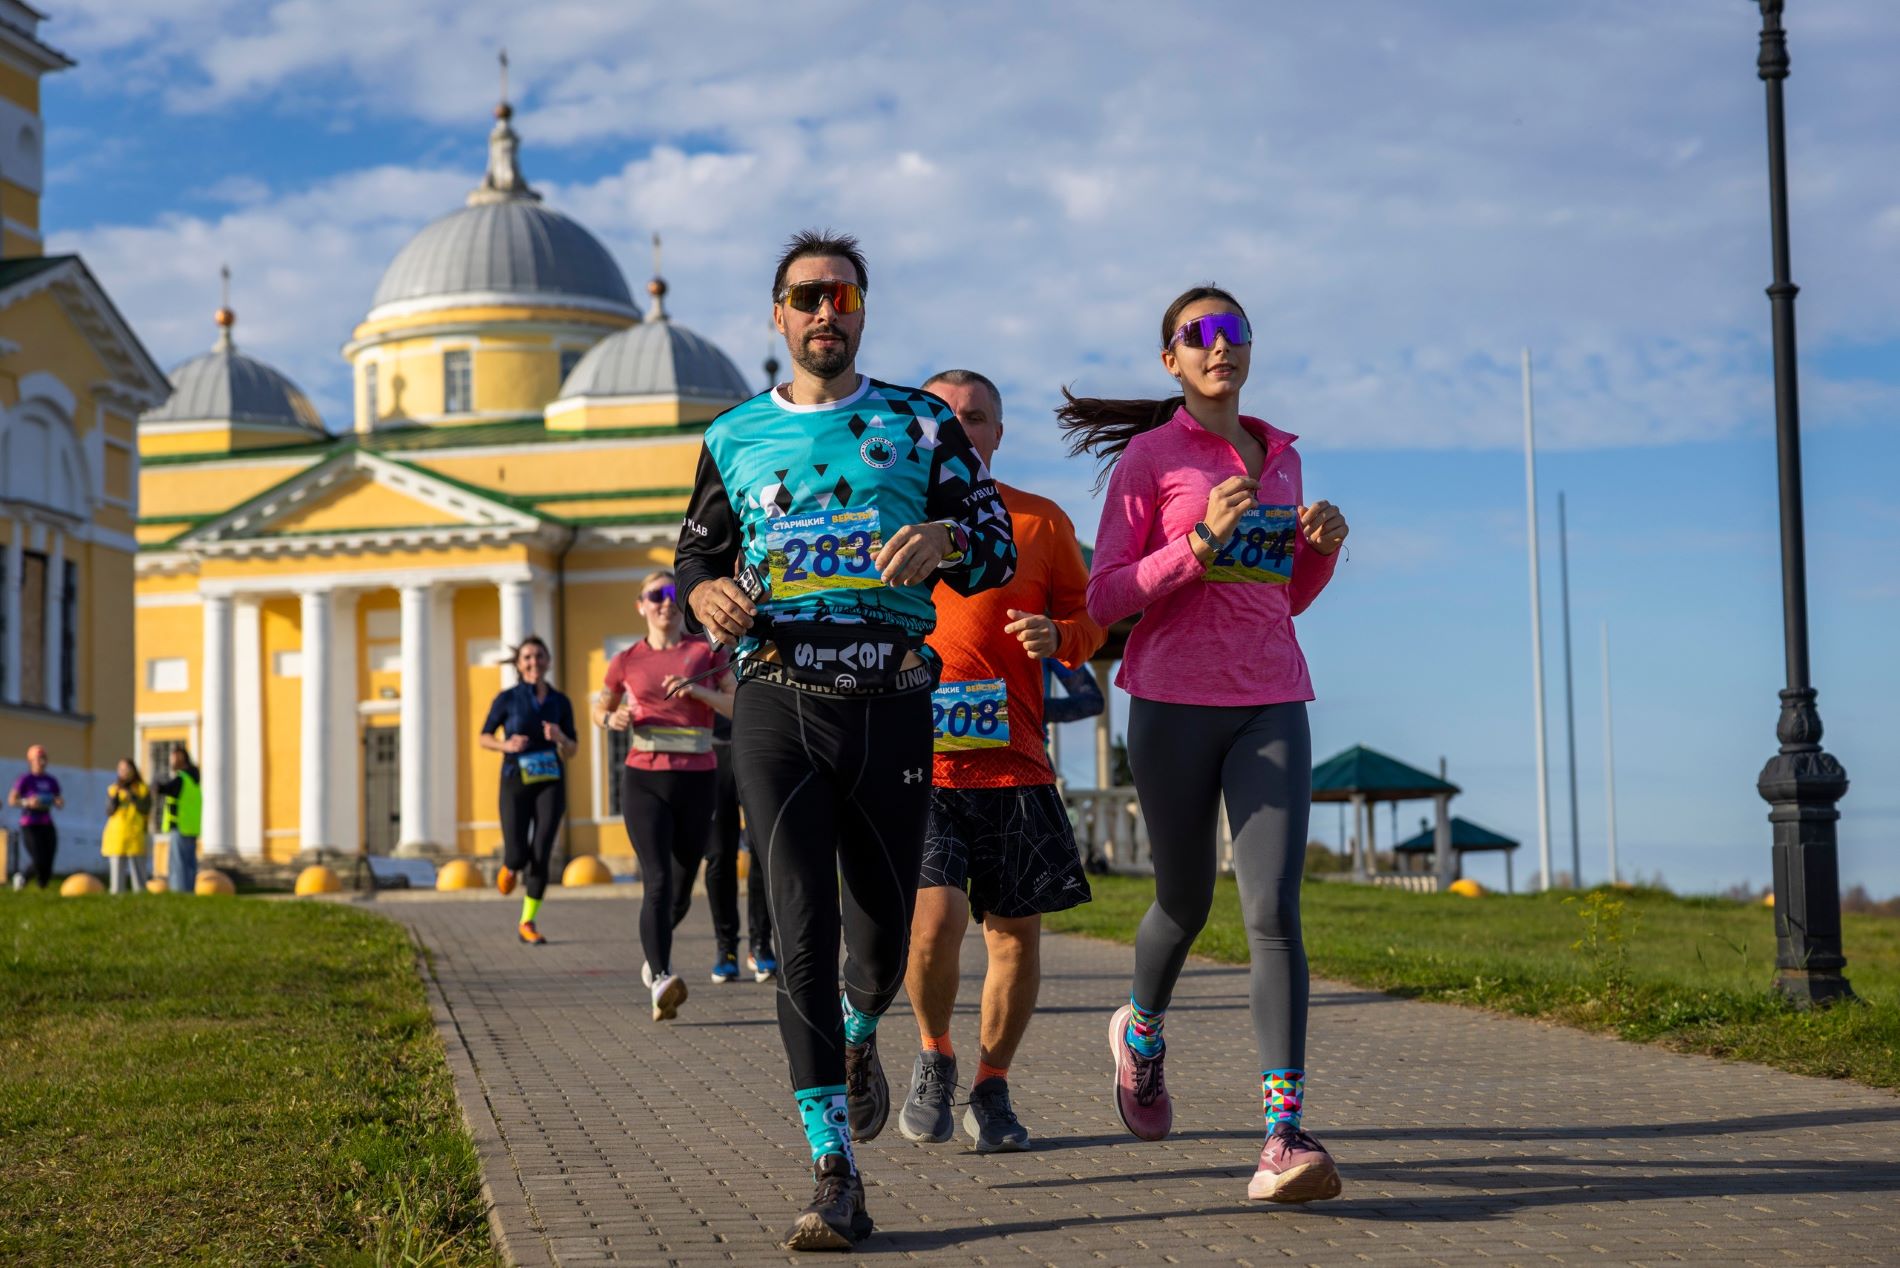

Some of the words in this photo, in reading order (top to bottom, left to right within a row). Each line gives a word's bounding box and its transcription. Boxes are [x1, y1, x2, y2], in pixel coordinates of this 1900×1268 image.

[772, 517, 825, 531] СТАРИЦКИЕ
[782, 530, 872, 582] 283
[1213, 526, 1290, 568] 284
[933, 699, 998, 738] 208
